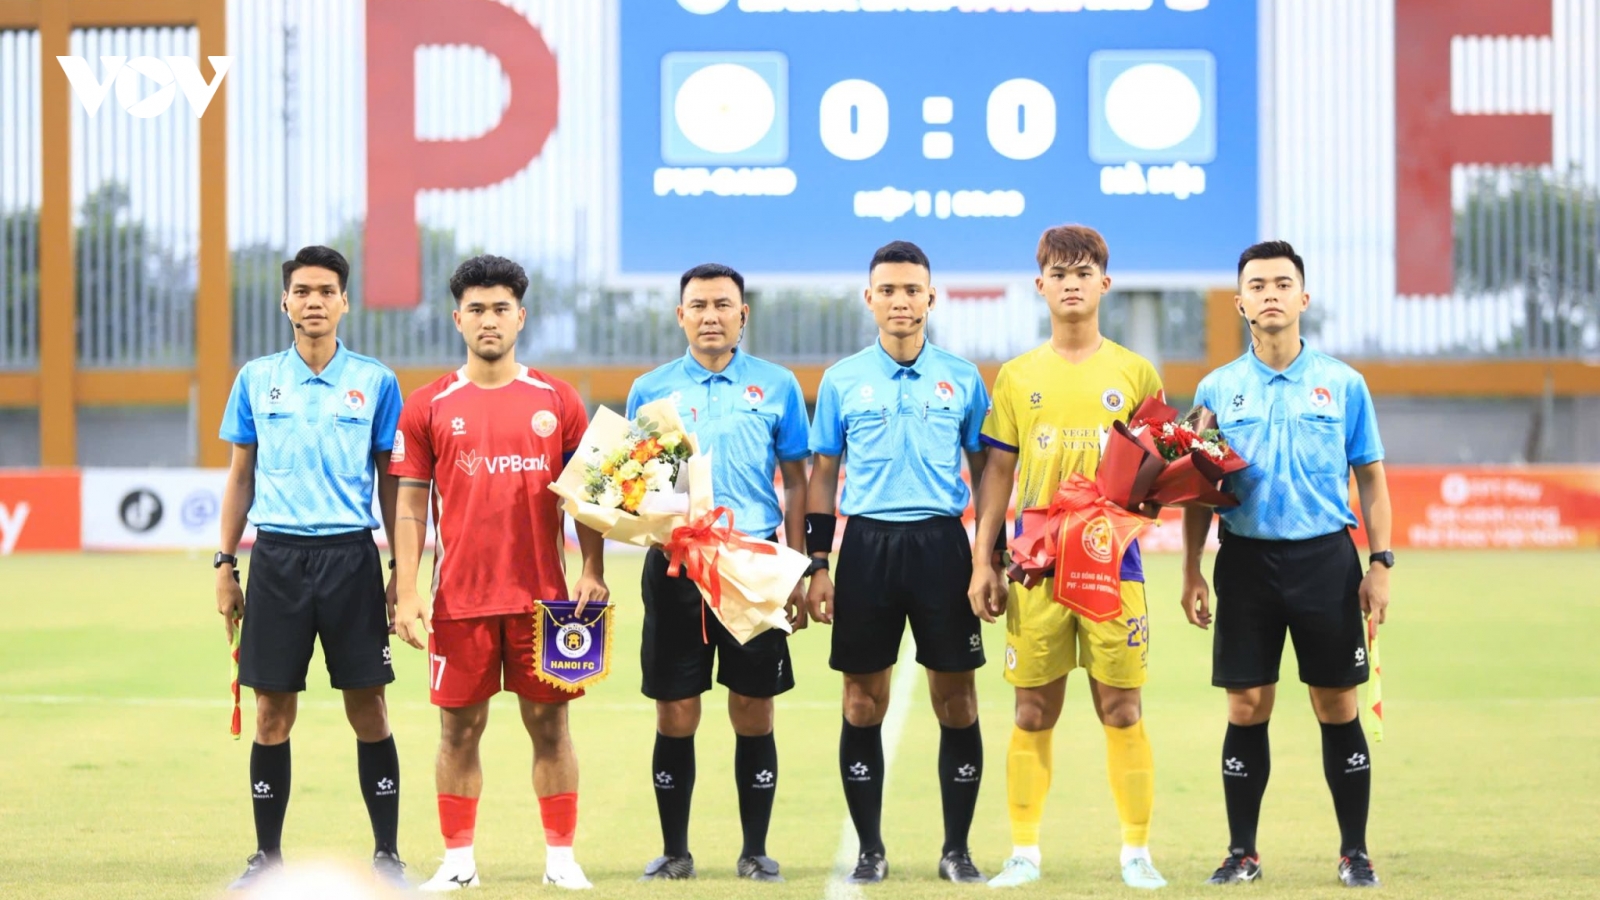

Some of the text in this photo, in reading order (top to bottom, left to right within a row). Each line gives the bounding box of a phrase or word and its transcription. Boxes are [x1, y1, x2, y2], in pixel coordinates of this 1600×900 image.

[819, 78, 890, 161] 0
[986, 77, 1057, 161] 0
[484, 453, 550, 474] VPBank
[1126, 615, 1147, 647] 28
[430, 652, 447, 691] 17
[550, 660, 595, 670] HANOI FC
